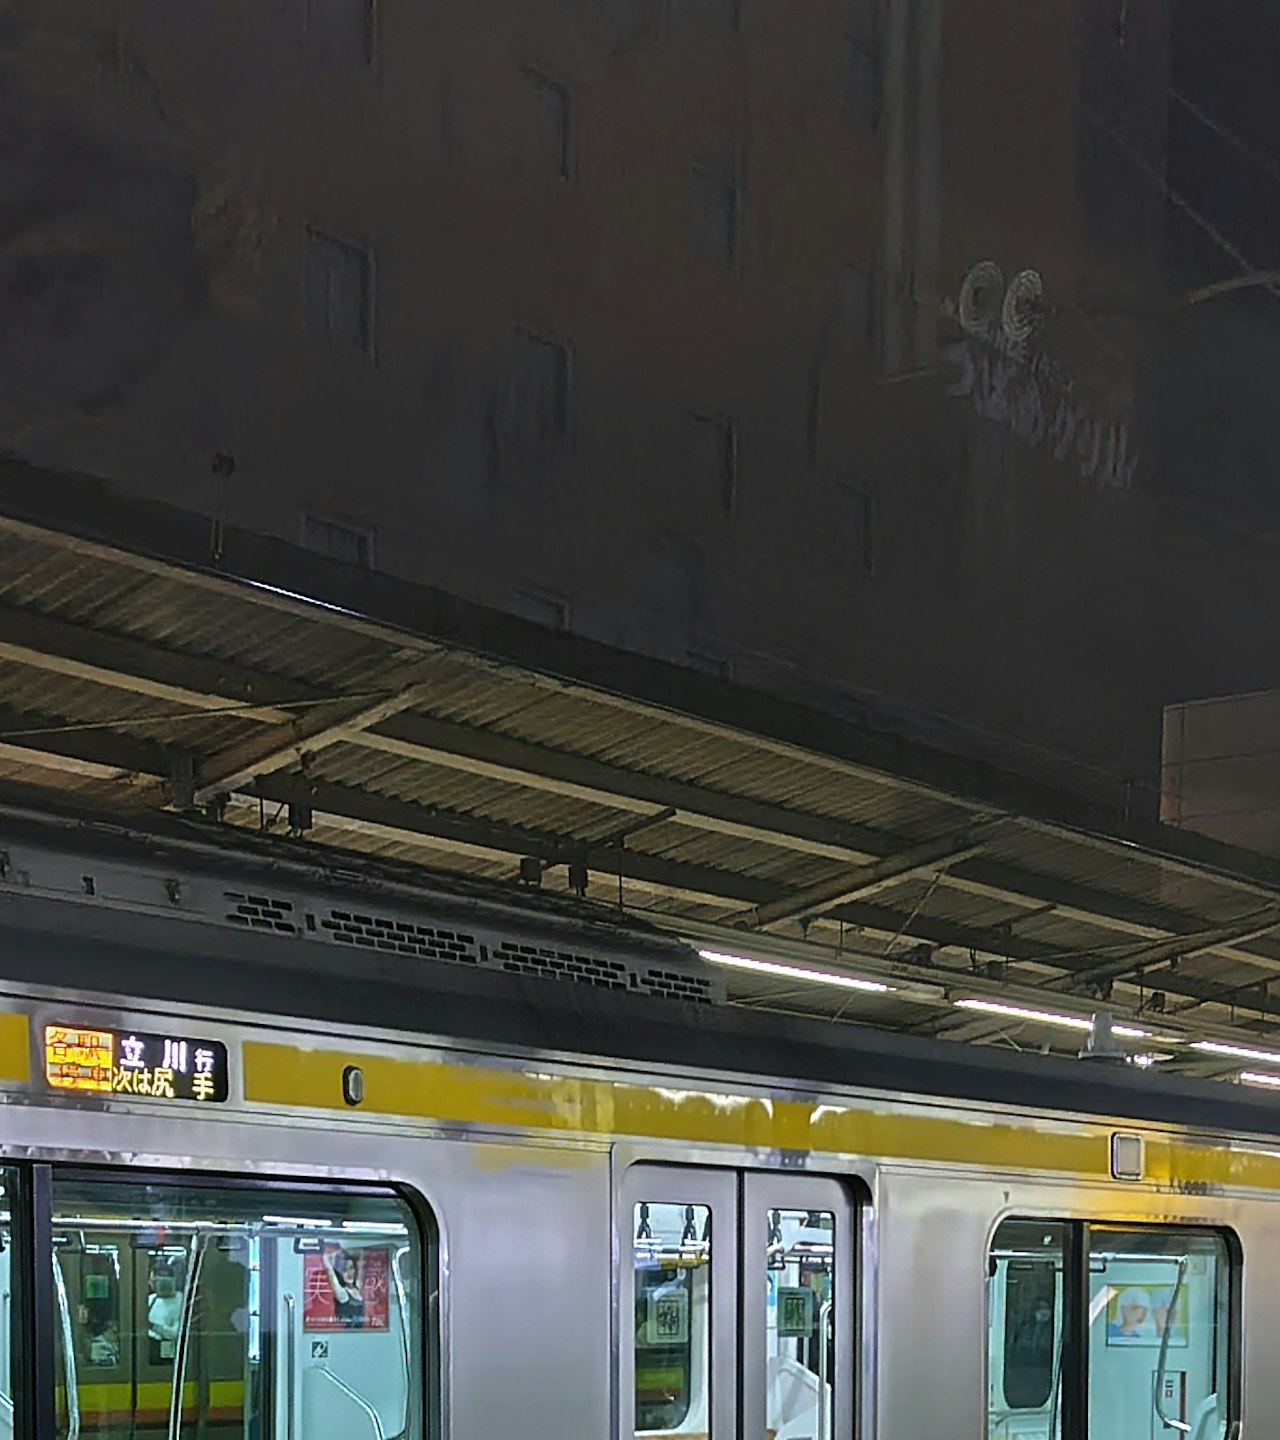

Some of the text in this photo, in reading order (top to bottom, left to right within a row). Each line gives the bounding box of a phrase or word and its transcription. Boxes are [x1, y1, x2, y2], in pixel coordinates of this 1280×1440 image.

[119, 1035, 215, 1074] 立川行
[112, 1066, 215, 1101] 次は尻手
